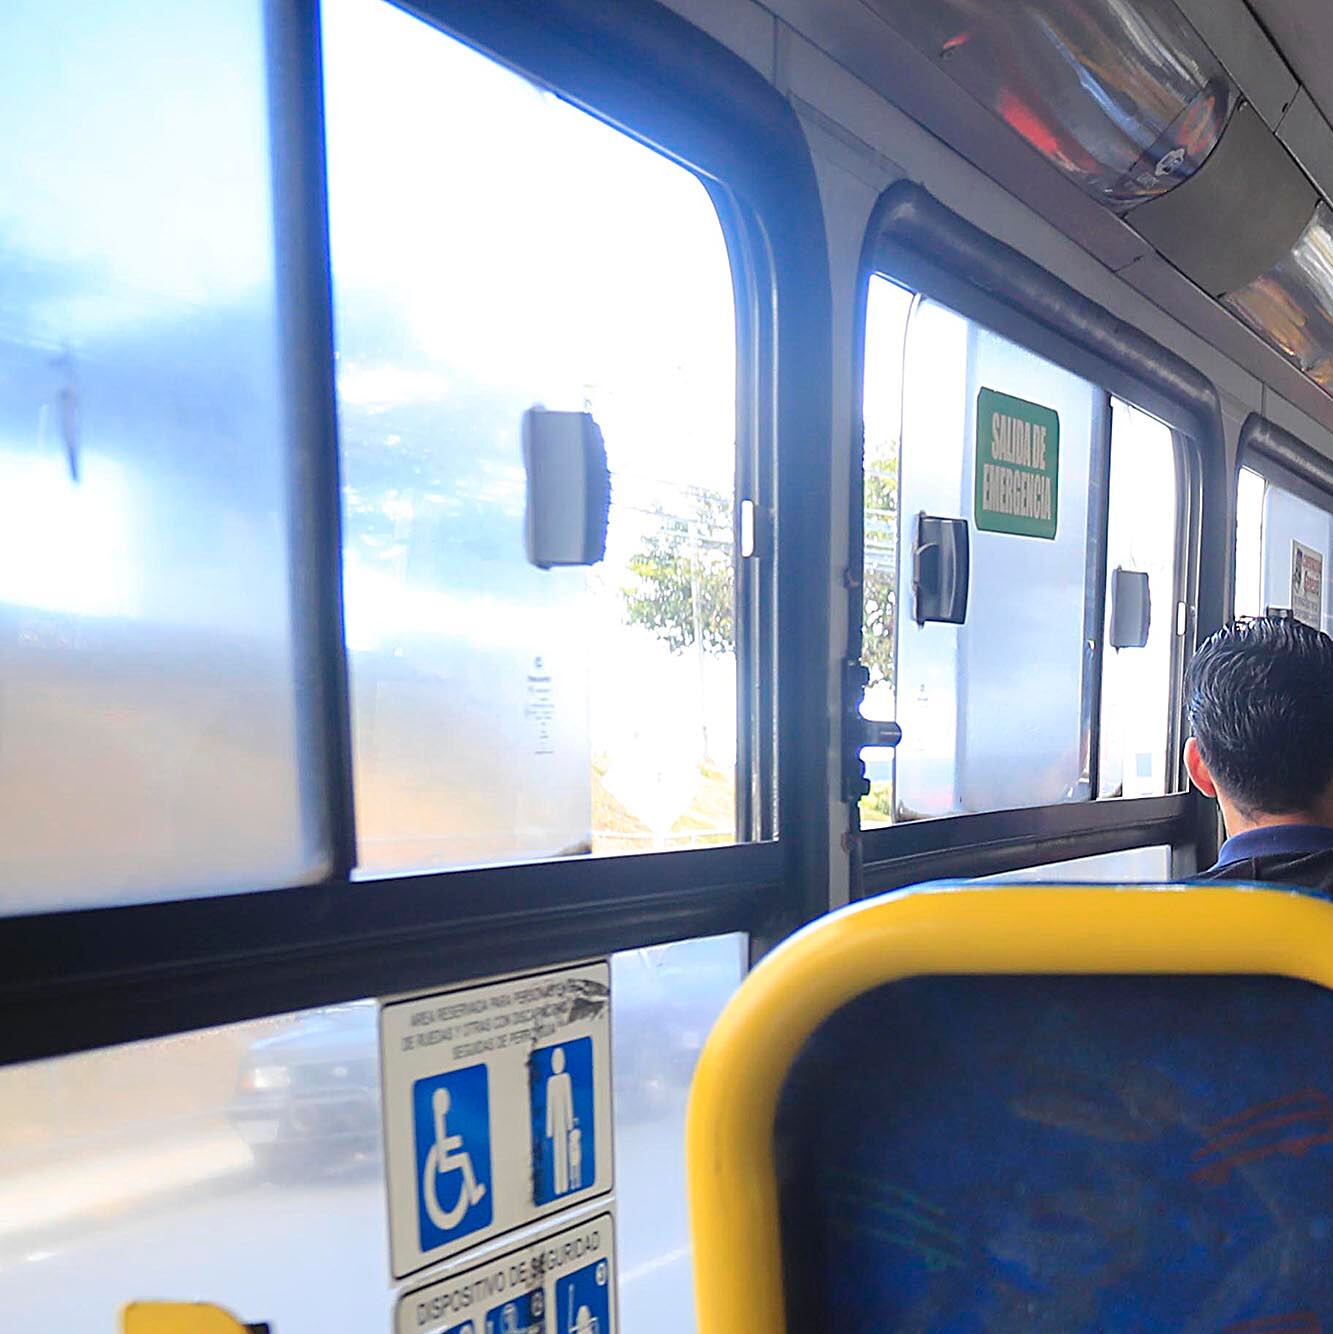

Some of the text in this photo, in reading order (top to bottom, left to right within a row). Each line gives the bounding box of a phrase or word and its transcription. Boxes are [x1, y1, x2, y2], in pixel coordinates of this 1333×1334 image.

[991, 411, 1047, 470] SALIDA DE
[983, 462, 1051, 520] EMERGENCIA
[417, 1230, 600, 1326] DISPOSITIVO DE SEGURIDAD
